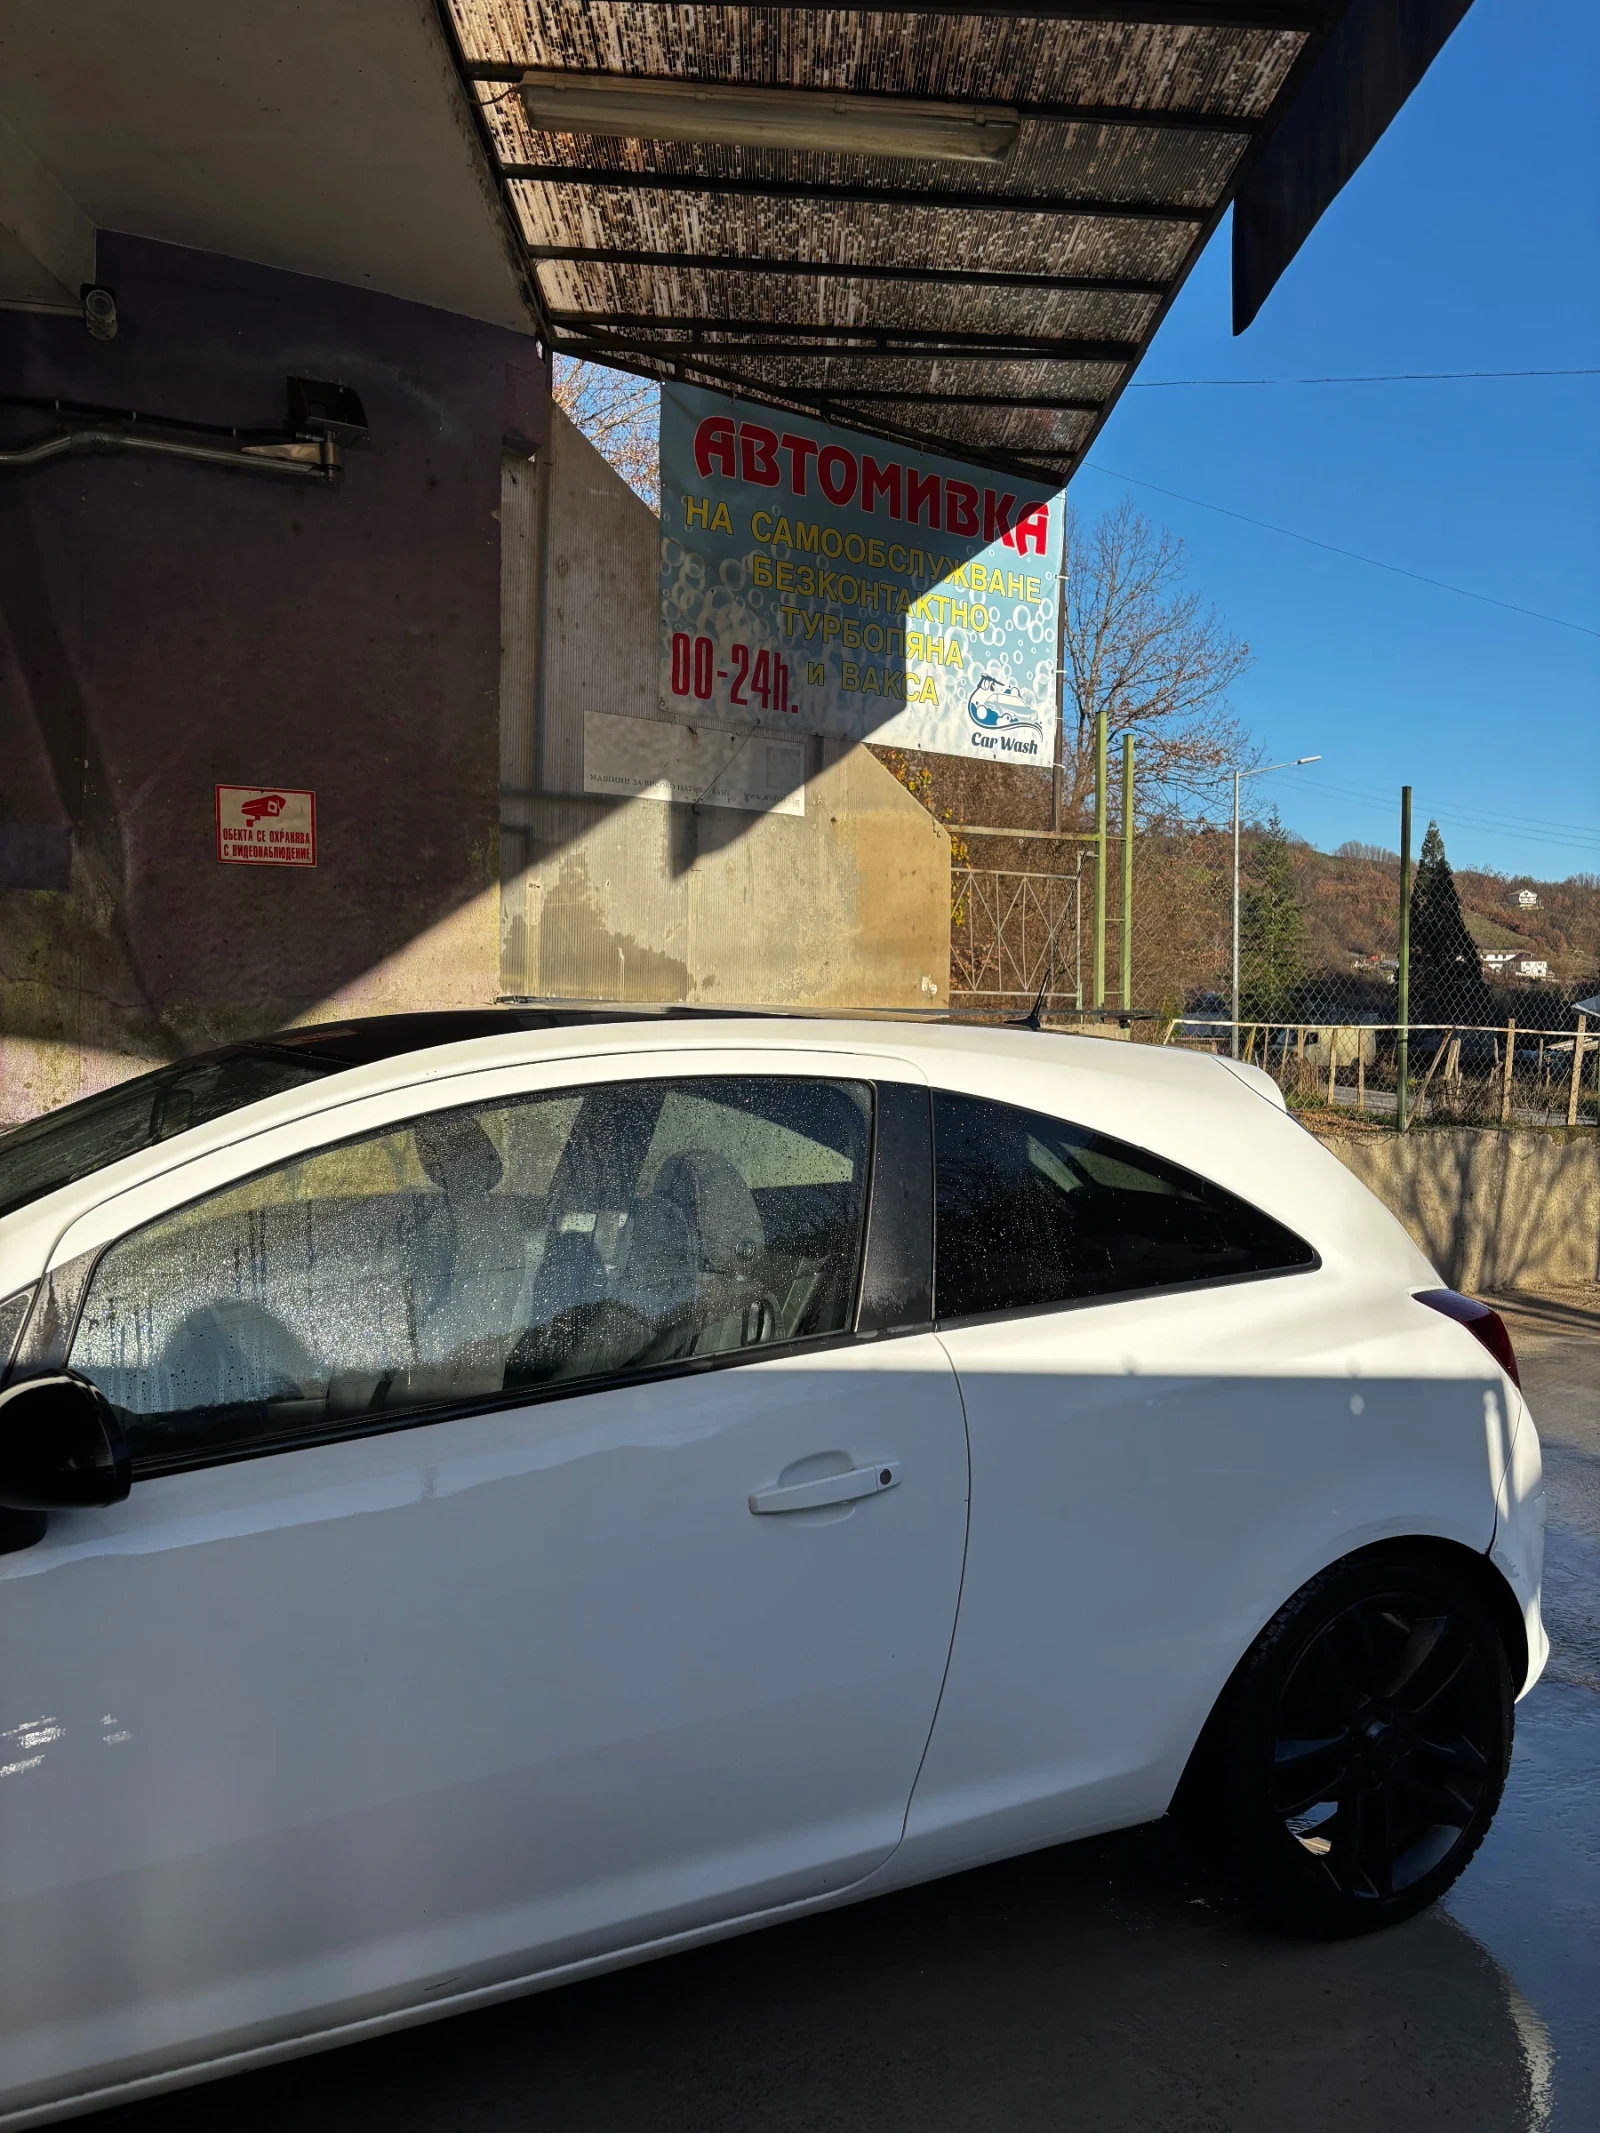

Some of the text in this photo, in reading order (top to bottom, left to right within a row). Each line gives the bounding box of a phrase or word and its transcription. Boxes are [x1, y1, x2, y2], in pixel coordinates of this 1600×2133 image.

[693, 415, 1050, 558] АВТОМИВКА
[685, 495, 1042, 605] НА САМООБСЛУЖВАНЕ
[752, 556, 989, 633] БЕЗКОНТАКТНО
[779, 606, 964, 670] ТУРБОПЯНА
[671, 632, 799, 715] 00-24h.
[841, 667, 940, 706] ВАКСА
[971, 731, 1038, 755] Car Wash
[590, 774, 631, 785] МАШИНИ
[632, 779, 644, 787] ЗА
[223, 828, 311, 845] ОБЕКТА СЕ ОХРАНЯВА
[223, 844, 310, 861] С ВИДЕОНАБЛЮДЕНИЕ
